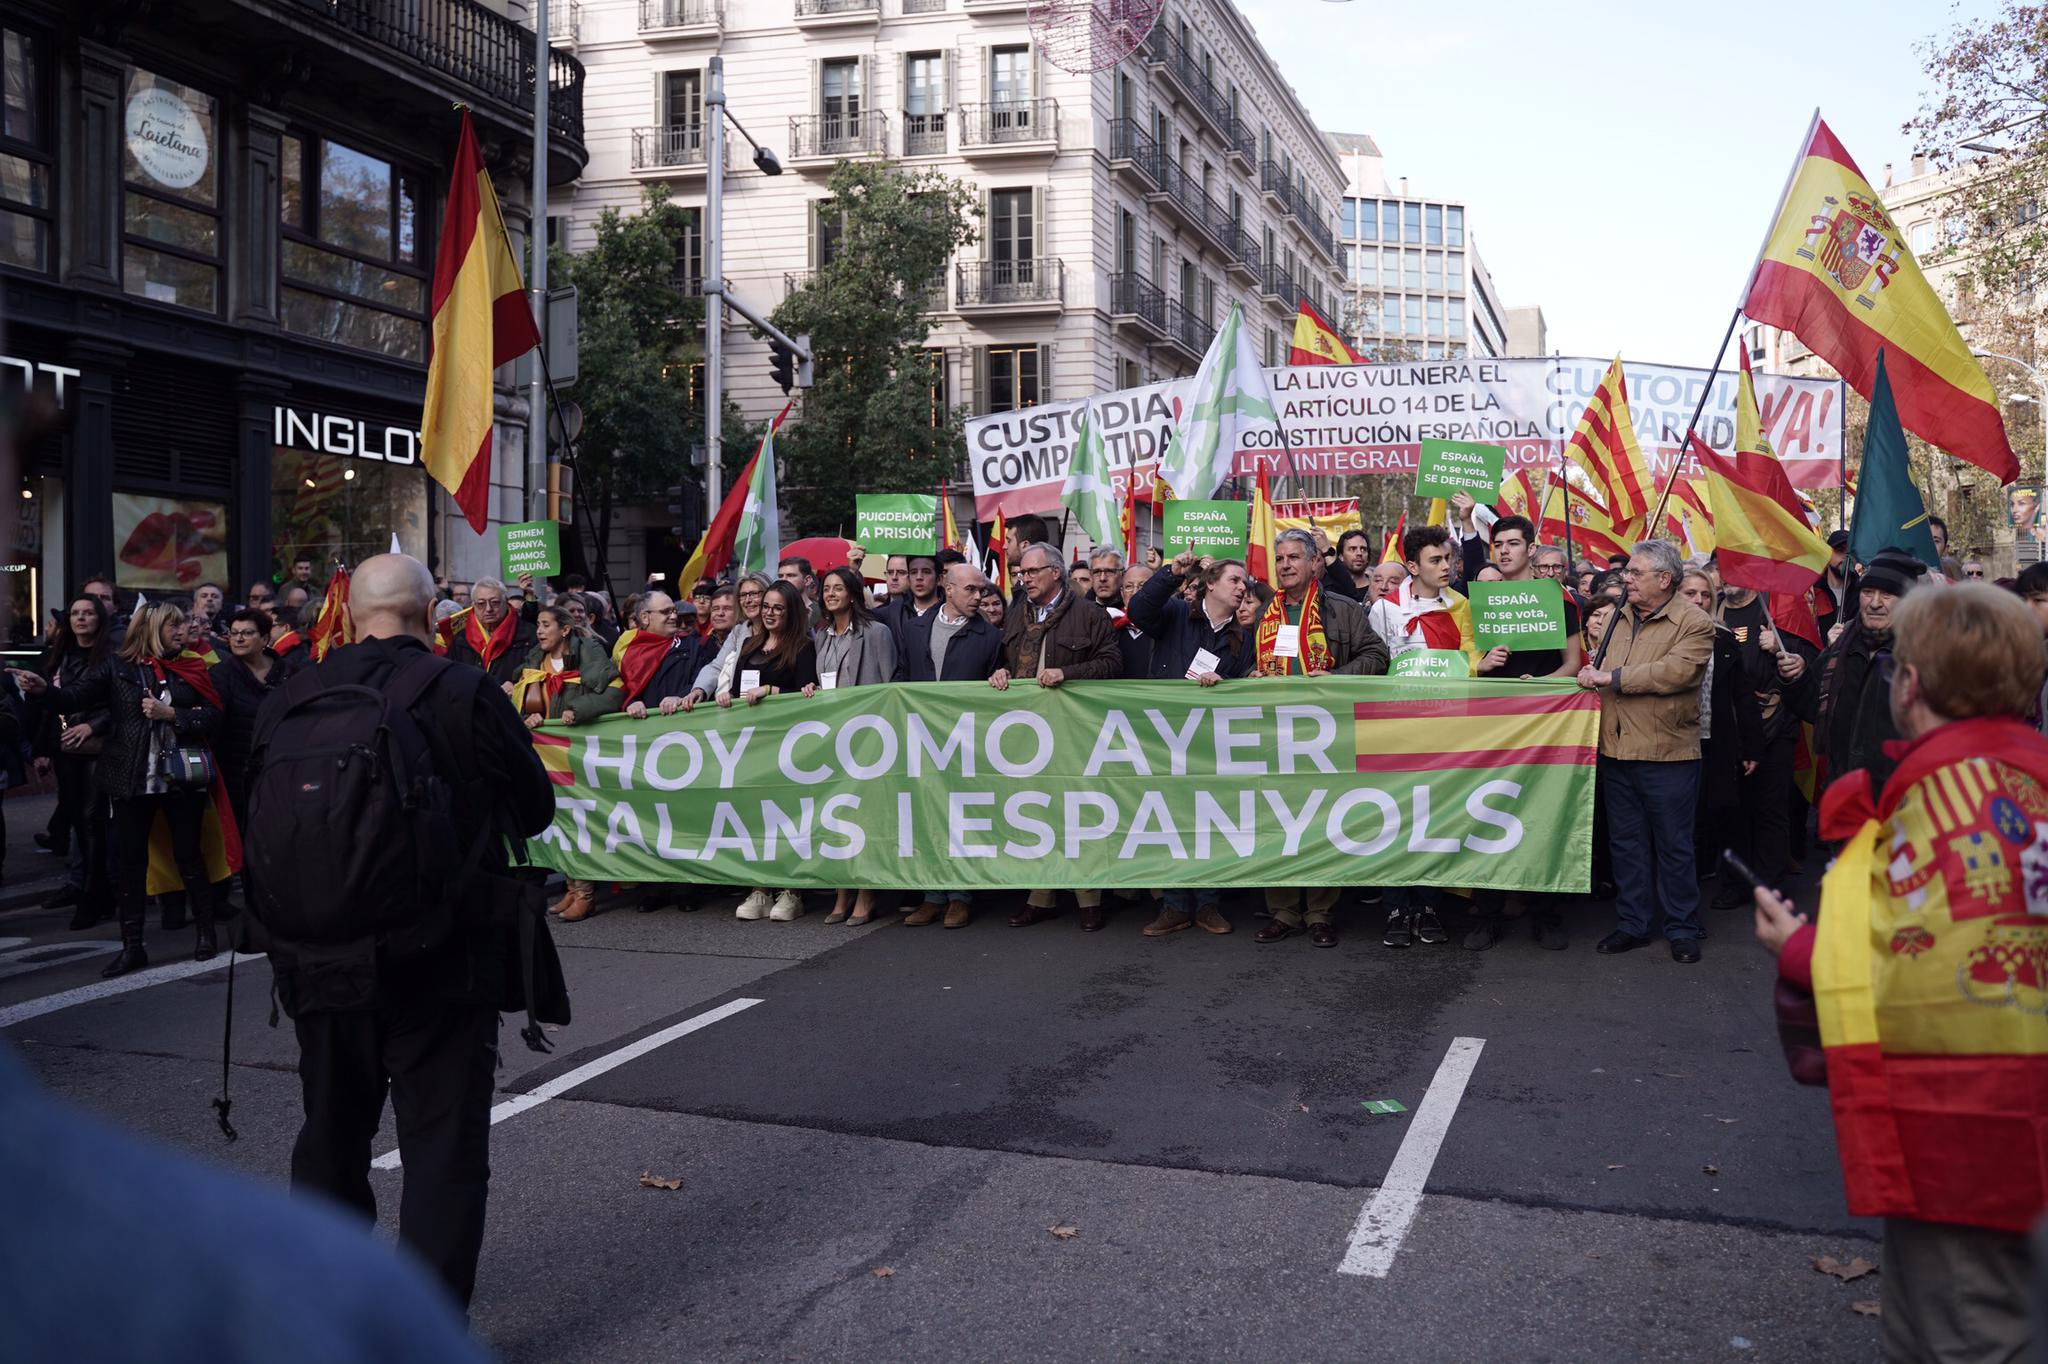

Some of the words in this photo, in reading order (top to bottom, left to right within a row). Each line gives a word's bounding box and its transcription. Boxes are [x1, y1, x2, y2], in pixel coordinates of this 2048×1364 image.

[133, 120, 201, 158] Laietana
[1273, 373, 1301, 391] LA
[1306, 371, 1358, 389] LIVG
[1363, 366, 1475, 387] VULNERA
[1479, 365, 1507, 383] EL
[1546, 367, 1737, 411] CUTODI
[1283, 395, 1396, 419] ARTÍCULO
[1402, 396, 1428, 414] 14
[1434, 394, 1465, 413] DE
[1471, 393, 1500, 411] LA
[1761, 384, 1834, 456] YA!
[275, 406, 421, 465] INGLO
[1242, 421, 1411, 448] CONSTITUCIÓN
[1418, 417, 1542, 440] ESPAÑOLA
[982, 425, 1173, 489] COMPTIDA
[1295, 450, 1417, 471] INTEGRAL
[1440, 451, 1484, 465] ESPAÑA
[1432, 464, 1447, 472] no
[1449, 465, 1461, 474] se
[1463, 467, 1488, 478] vota,
[1424, 473, 1438, 483] SE
[1440, 475, 1494, 490] DEFIENDE
[859, 511, 935, 522] PUIGDEMONT
[1183, 510, 1227, 521] ESPAÑA
[507, 528, 544, 539] ESTIMEM
[860, 527, 870, 538] A
[874, 525, 932, 539] PRISIÓN
[1192, 525, 1205, 533] se
[1207, 525, 1233, 535] vota,
[507, 539, 547, 551] ESPANYA,
[1170, 535, 1183, 544] SE
[1185, 536, 1240, 545] DEFIENDE
[510, 550, 546, 561] AMAMOS
[508, 560, 551, 573] CATALUÑA
[1487, 592, 1539, 606] ESPAÑA
[1483, 611, 1496, 619] no
[1499, 610, 1512, 620] se
[1515, 609, 1548, 620] vota,
[1478, 623, 1491, 634] SE
[1492, 621, 1558, 634] DEFIENDE
[1396, 657, 1449, 670] ESTIMEM
[582, 726, 757, 791] HOY
[777, 709, 1055, 785] COMO
[1083, 704, 1339, 776] AYER
[531, 793, 866, 861] ATALANS
[898, 792, 913, 858] I
[947, 779, 1525, 860] ESPANYOLS
